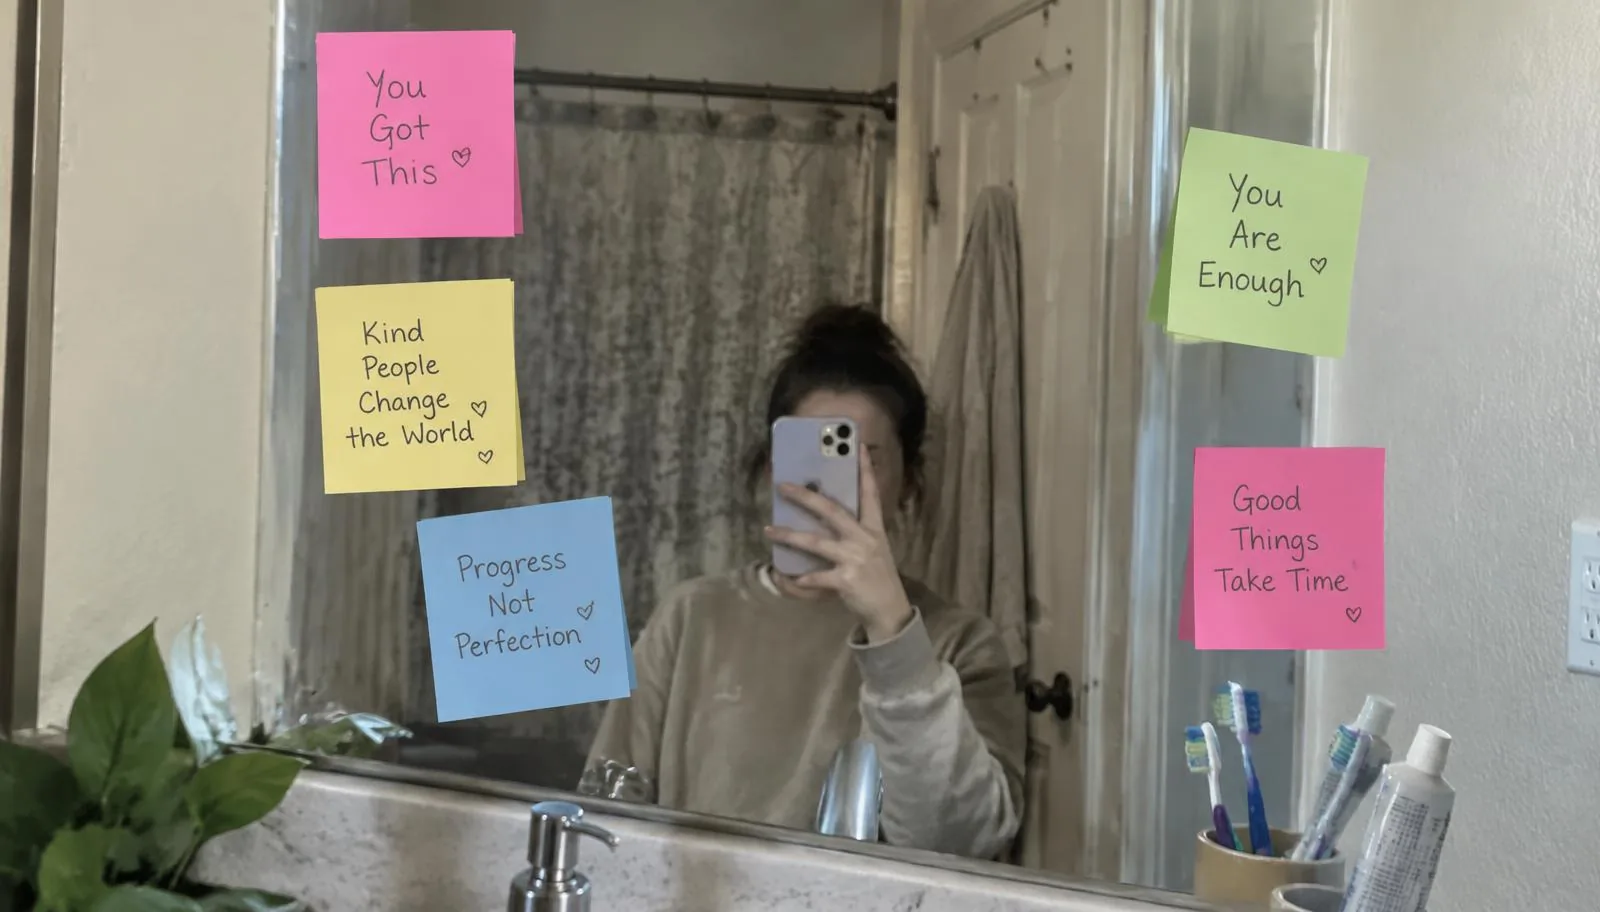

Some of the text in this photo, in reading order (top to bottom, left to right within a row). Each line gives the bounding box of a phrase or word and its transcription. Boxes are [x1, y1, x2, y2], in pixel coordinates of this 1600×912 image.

[367, 69, 427, 108] You
[370, 114, 431, 150] Got
[361, 157, 438, 186] This
[1229, 173, 1284, 213] You
[1229, 219, 1282, 252] Are
[1198, 260, 1305, 308] Enough
[363, 318, 425, 346] Kind
[361, 353, 440, 386] People
[358, 389, 451, 421] Change
[345, 420, 475, 449] the World
[1233, 484, 1302, 516] Good
[1230, 526, 1320, 563] Things
[456, 552, 568, 588] Progress
[1213, 567, 1349, 593] Take Time
[488, 588, 536, 618] Not
[454, 625, 582, 660] Perfection
